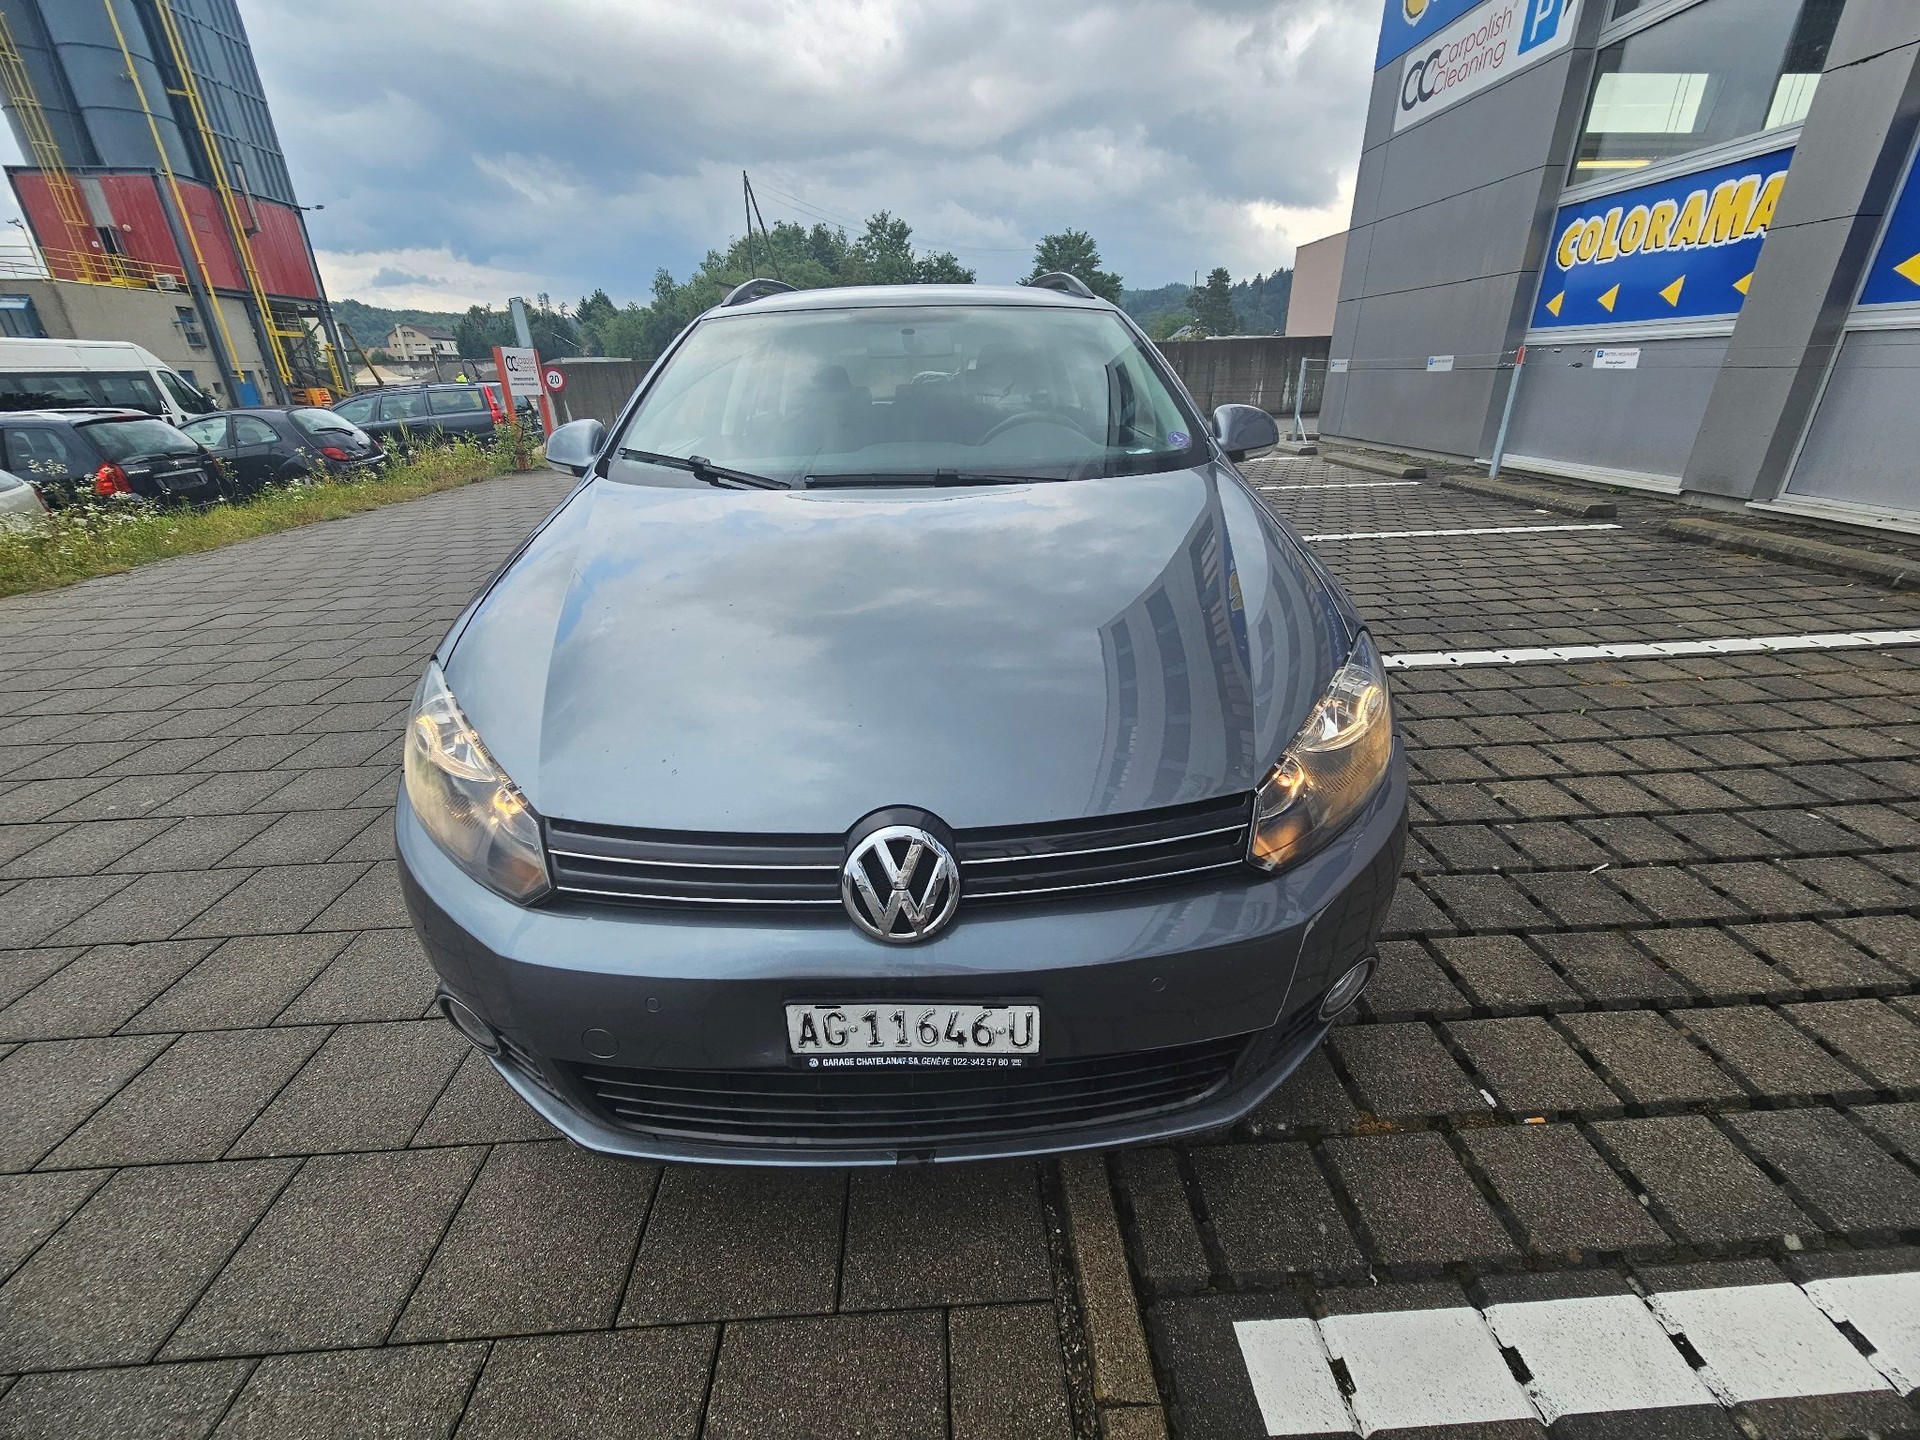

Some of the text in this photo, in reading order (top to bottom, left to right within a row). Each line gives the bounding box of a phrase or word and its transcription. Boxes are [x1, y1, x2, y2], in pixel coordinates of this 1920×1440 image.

[1432, 39, 1508, 96] Cleaning
[1557, 172, 1787, 270] COLORAMA
[549, 375, 560, 384] 20
[822, 1058, 855, 1067] GARAGE
[921, 1056, 950, 1066] GENÈVE
[952, 1058, 986, 1066] 022-342
